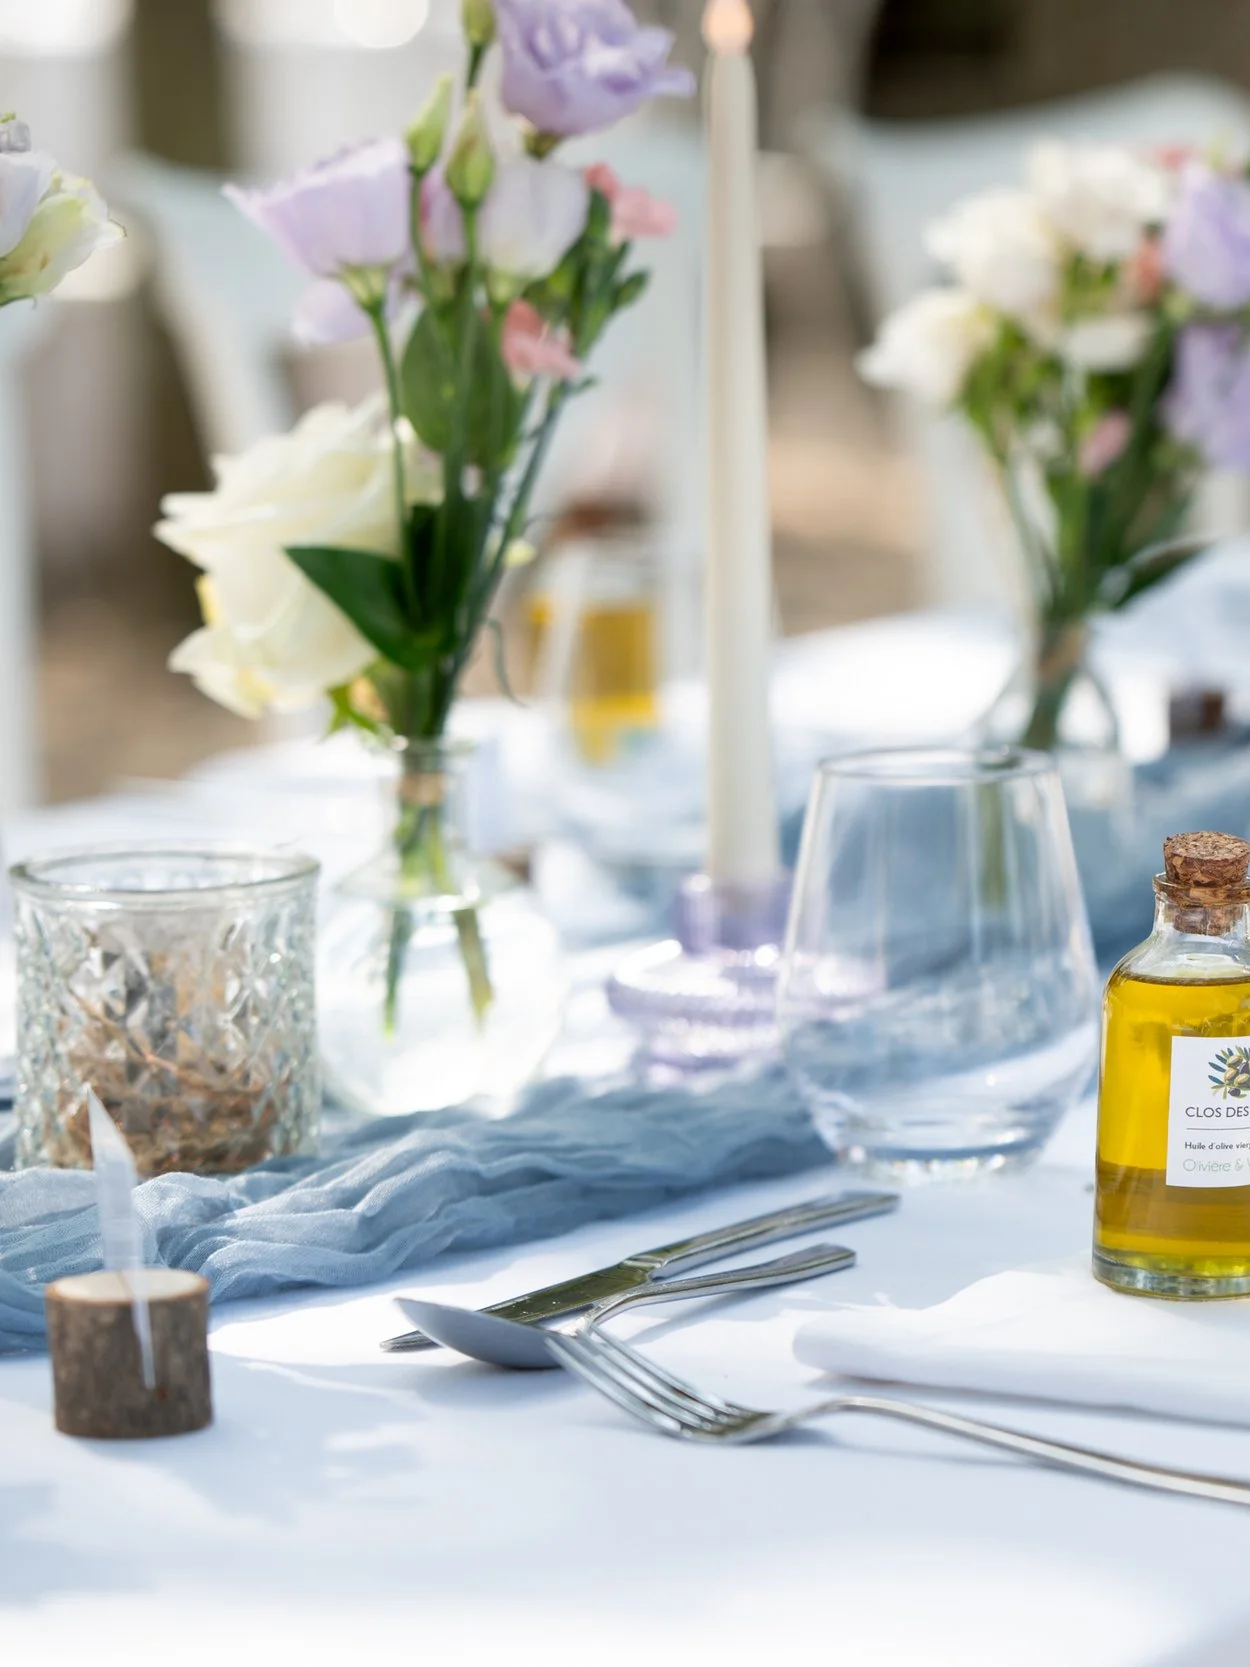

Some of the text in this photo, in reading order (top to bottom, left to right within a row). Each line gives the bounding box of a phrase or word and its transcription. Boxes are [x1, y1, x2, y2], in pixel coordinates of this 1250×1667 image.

[1185, 1106, 1222, 1118] CLOS
[1226, 1106, 1249, 1118] DES
[1184, 1141, 1206, 1150] Huile
[1235, 1158, 1243, 1171] &
